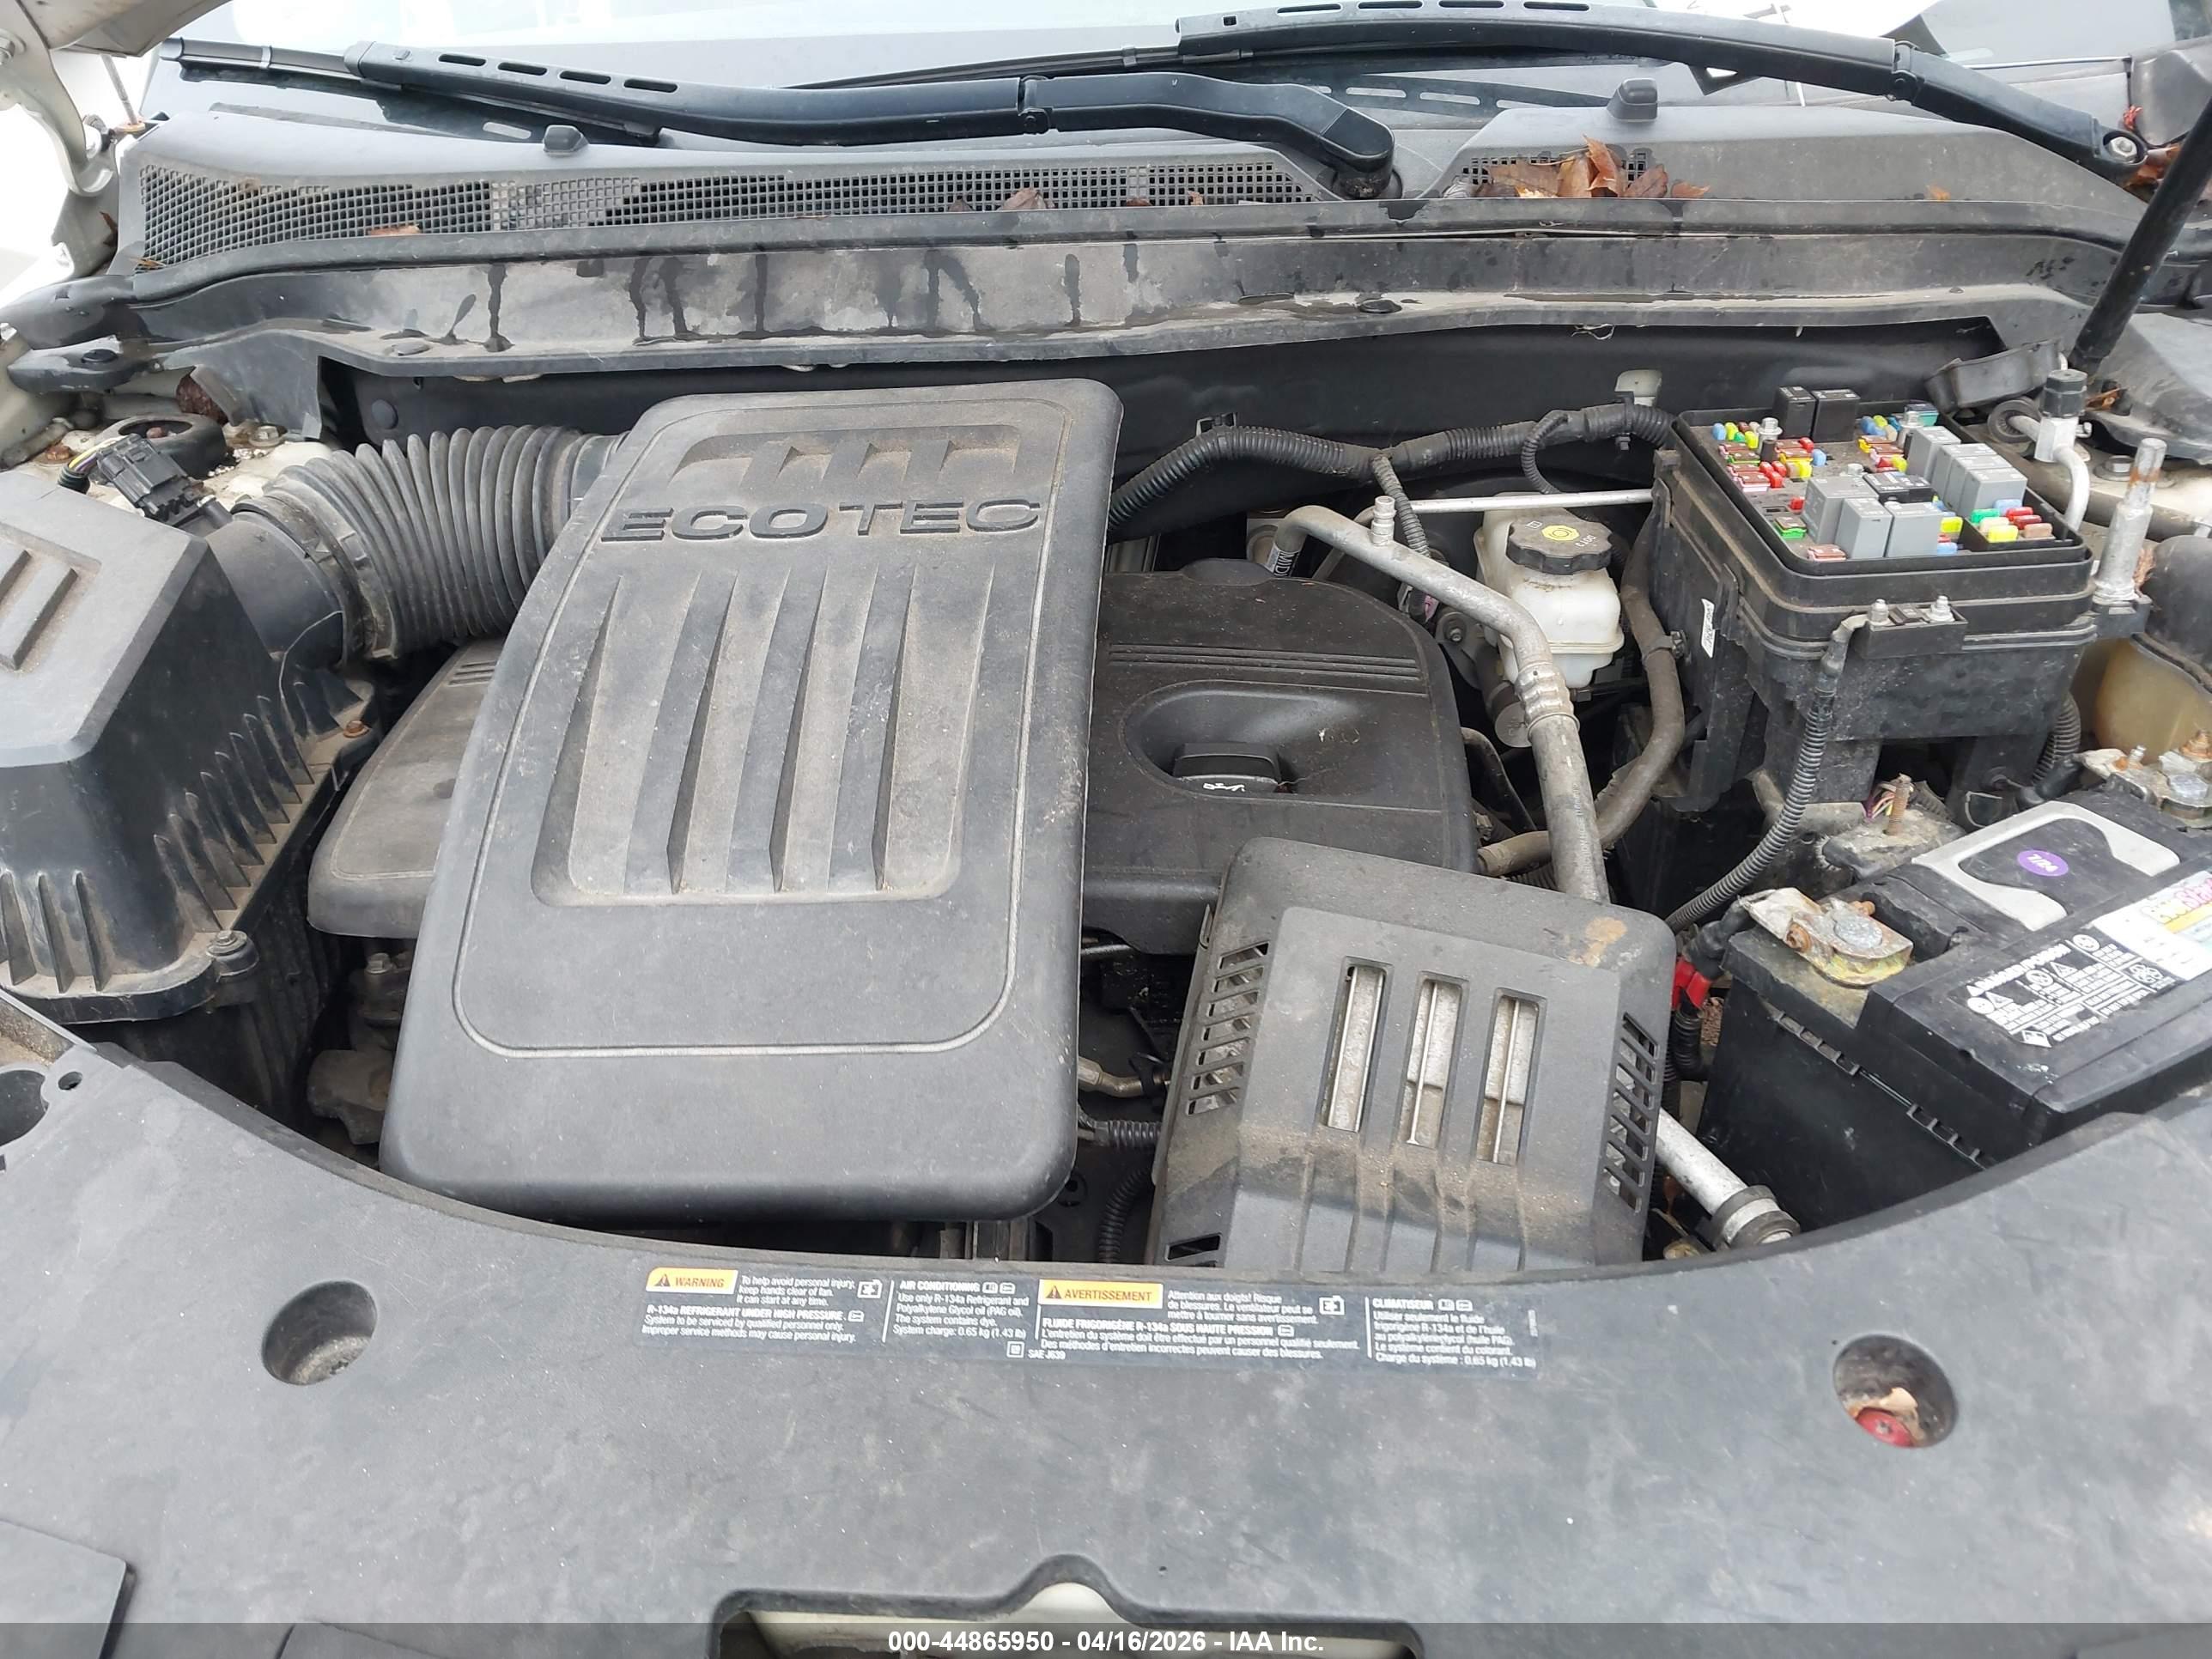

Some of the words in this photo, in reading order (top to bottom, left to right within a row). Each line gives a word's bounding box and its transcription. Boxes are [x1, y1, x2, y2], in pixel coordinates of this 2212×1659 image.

[599, 498, 1041, 542] ECOTEC
[675, 1278, 724, 1288] WARNING
[900, 1281, 915, 1291] AIR
[917, 1281, 981, 1292] CONDITIONING
[898, 1292, 914, 1302] Use
[915, 1293, 933, 1304] only
[934, 1293, 965, 1304] R-134a
[967, 1295, 1012, 1306] Refrigerant
[1013, 1297, 1029, 1305] and
[1065, 1290, 1152, 1302] AVERTISSEMENT
[1168, 1290, 1204, 1300] Attention
[1206, 1293, 1222, 1302] aux
[1223, 1293, 1251, 1304] doigts!
[1254, 1293, 1281, 1304] Risque
[896, 1302, 947, 1315] Polyalkylene
[948, 1304, 974, 1315] Glycol
[975, 1305, 986, 1314] oil
[988, 1305, 1007, 1317] (PAG
[1008, 1307, 1023, 1317] oil).
[1167, 1301, 1179, 1310] de
[1180, 1302, 1222, 1311] blessures.
[1224, 1303, 1235, 1311] Le
[1236, 1303, 1279, 1314] ventilateur
[1281, 1305, 1300, 1315] peut
[1372, 1298, 1434, 1310] CLIMATISEUR
[647, 1305, 678, 1315] R-134a
[680, 1306, 740, 1316] REFRIGERANT
[742, 1308, 772, 1318] UNDER
[773, 1310, 795, 1319] HIGH
[1167, 1310, 1195, 1320] mettre
[1204, 1312, 1235, 1322] tourner
[1237, 1314, 1256, 1322] sans
[1258, 1314, 1318, 1324] avertissement.
[644, 1315, 675, 1325] System
[699, 1317, 733, 1326] serviced
[735, 1319, 745, 1328] by
[747, 1319, 781, 1329] qualified
[783, 1321, 823, 1331] personnel
[824, 1322, 844, 1331] only.
[896, 1314, 910, 1323] The
[912, 1314, 943, 1325] system
[943, 1316, 979, 1326] contains
[980, 1317, 997, 1328] dye.
[1042, 1318, 1074, 1328] FLUIDE
[1075, 1319, 1135, 1331] FRIGORIGÈNE
[1136, 1321, 1169, 1332] R-134a
[1170, 1322, 1195, 1333] SOUS
[1195, 1324, 1226, 1334] HAUTE
[1228, 1324, 1273, 1336] PRESSION
[642, 1325, 678, 1335] Improper
[680, 1328, 710, 1336] service
[712, 1328, 747, 1338] methods
[749, 1330, 766, 1340] may
[768, 1330, 793, 1339] cause
[793, 1331, 830, 1341] personal
[831, 1332, 856, 1343] injury.
[893, 1324, 924, 1335] System
[926, 1326, 957, 1337] charge:
[957, 1327, 977, 1336] 0.65
[979, 1328, 990, 1339] kg
[991, 1328, 1013, 1339] (1.43
[1015, 1328, 1027, 1340] lb)
[1042, 1329, 1085, 1340] L'entretien
[1087, 1331, 1097, 1340] du
[1099, 1331, 1135, 1343] système
[1136, 1333, 1152, 1342] doit
[1154, 1333, 1171, 1343] être
[1172, 1333, 1206, 1345] effectué
[1207, 1337, 1223, 1346] par
[1237, 1337, 1278, 1347] personnel
[1279, 1338, 1312, 1349] qualifié
[1313, 1340, 1360, 1350] seulement.
[1028, 1350, 1045, 1358] SAE
[1046, 1350, 1066, 1360] J639
[1041, 1339, 1058, 1348] Des
[1059, 1340, 1100, 1351] méthodes
[1101, 1341, 1147, 1352] d'entretien
[1148, 1343, 1195, 1354] incorrectes
[1195, 1346, 1231, 1357] peuvent
[1231, 1346, 1261, 1357] causer
[1262, 1347, 1279, 1357] des
[1279, 1348, 1322, 1358] blessures.
